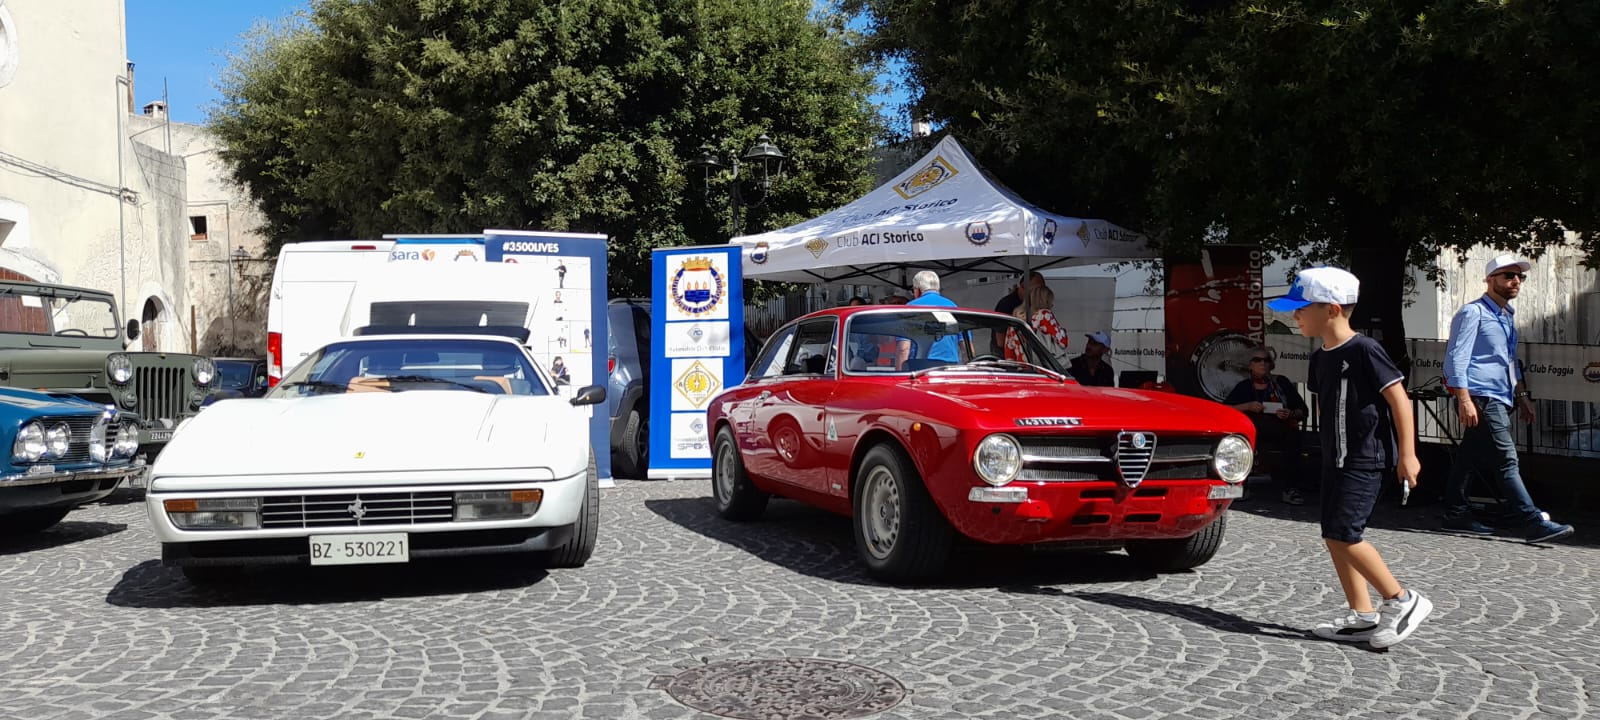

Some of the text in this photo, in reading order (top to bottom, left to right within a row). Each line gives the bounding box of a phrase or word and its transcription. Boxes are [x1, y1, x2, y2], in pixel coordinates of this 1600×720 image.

[904, 198, 958, 211] Storico
[836, 230, 924, 248] Club ACI Storico
[502, 241, 560, 253] #3500LIVES
[391, 250, 419, 261] sara
[1246, 250, 1263, 344] ACI Storico
[1143, 347, 1154, 356] Club
[1155, 347, 1165, 358] Fog
[1416, 358, 1431, 368] Club
[1529, 363, 1546, 374] Club
[1547, 364, 1574, 377] Foggia
